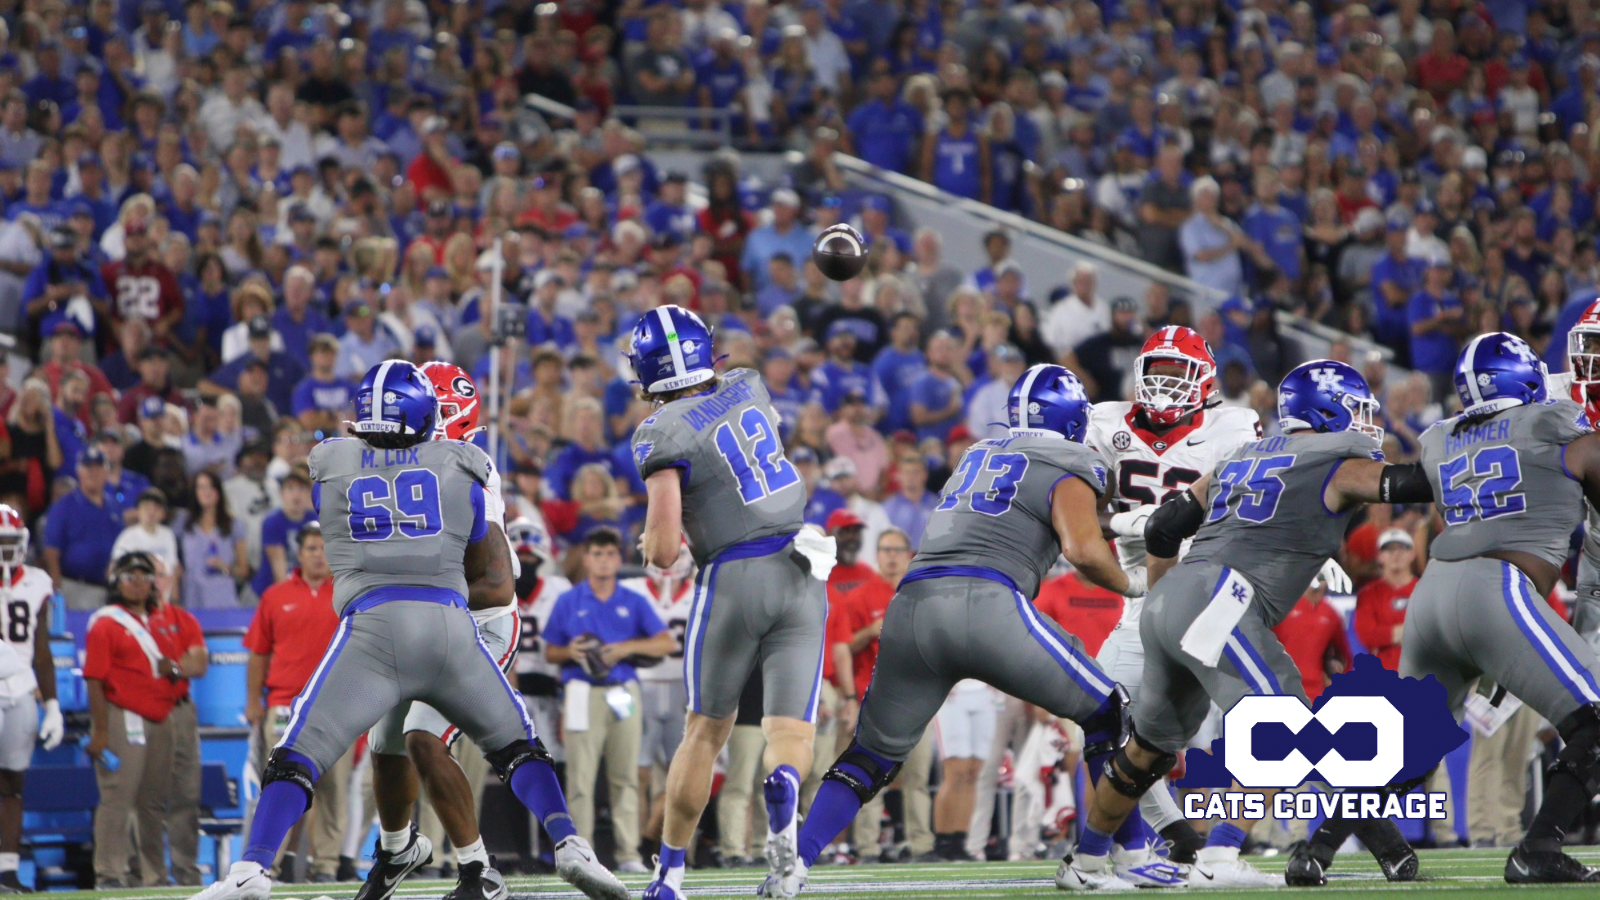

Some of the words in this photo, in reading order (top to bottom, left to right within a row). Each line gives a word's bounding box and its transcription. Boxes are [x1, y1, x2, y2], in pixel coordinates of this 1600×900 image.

[116, 275, 161, 319] 22
[663, 374, 703, 389] KENTUCKY
[1309, 368, 1344, 391] UK
[360, 422, 395, 432] KENTUCKY
[1113, 434, 1131, 447] SEC
[361, 449, 378, 468] M.
[714, 405, 801, 506] 12
[935, 448, 1029, 517] 73
[1206, 454, 1297, 524] 75
[1438, 444, 1526, 526] 52
[346, 468, 443, 541] 69
[1231, 579, 1249, 604] UK
